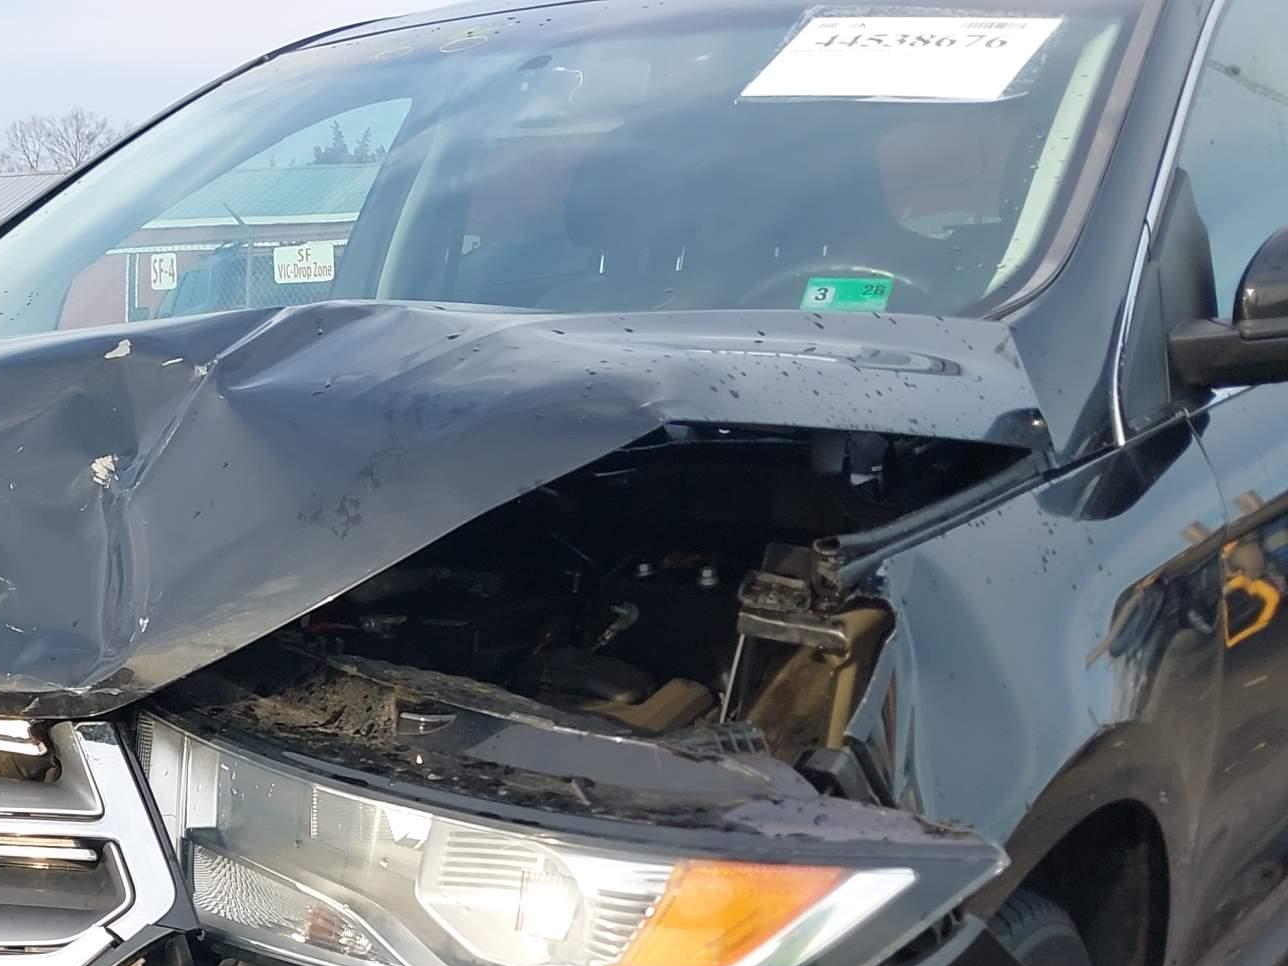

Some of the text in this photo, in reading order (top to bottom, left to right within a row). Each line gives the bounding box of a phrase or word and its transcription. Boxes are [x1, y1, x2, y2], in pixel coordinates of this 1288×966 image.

[816, 33, 1010, 48] 44538676
[297, 248, 312, 262] SF
[152, 258, 175, 284] SF-4
[313, 261, 332, 279] Zone
[814, 287, 829, 301] 3
